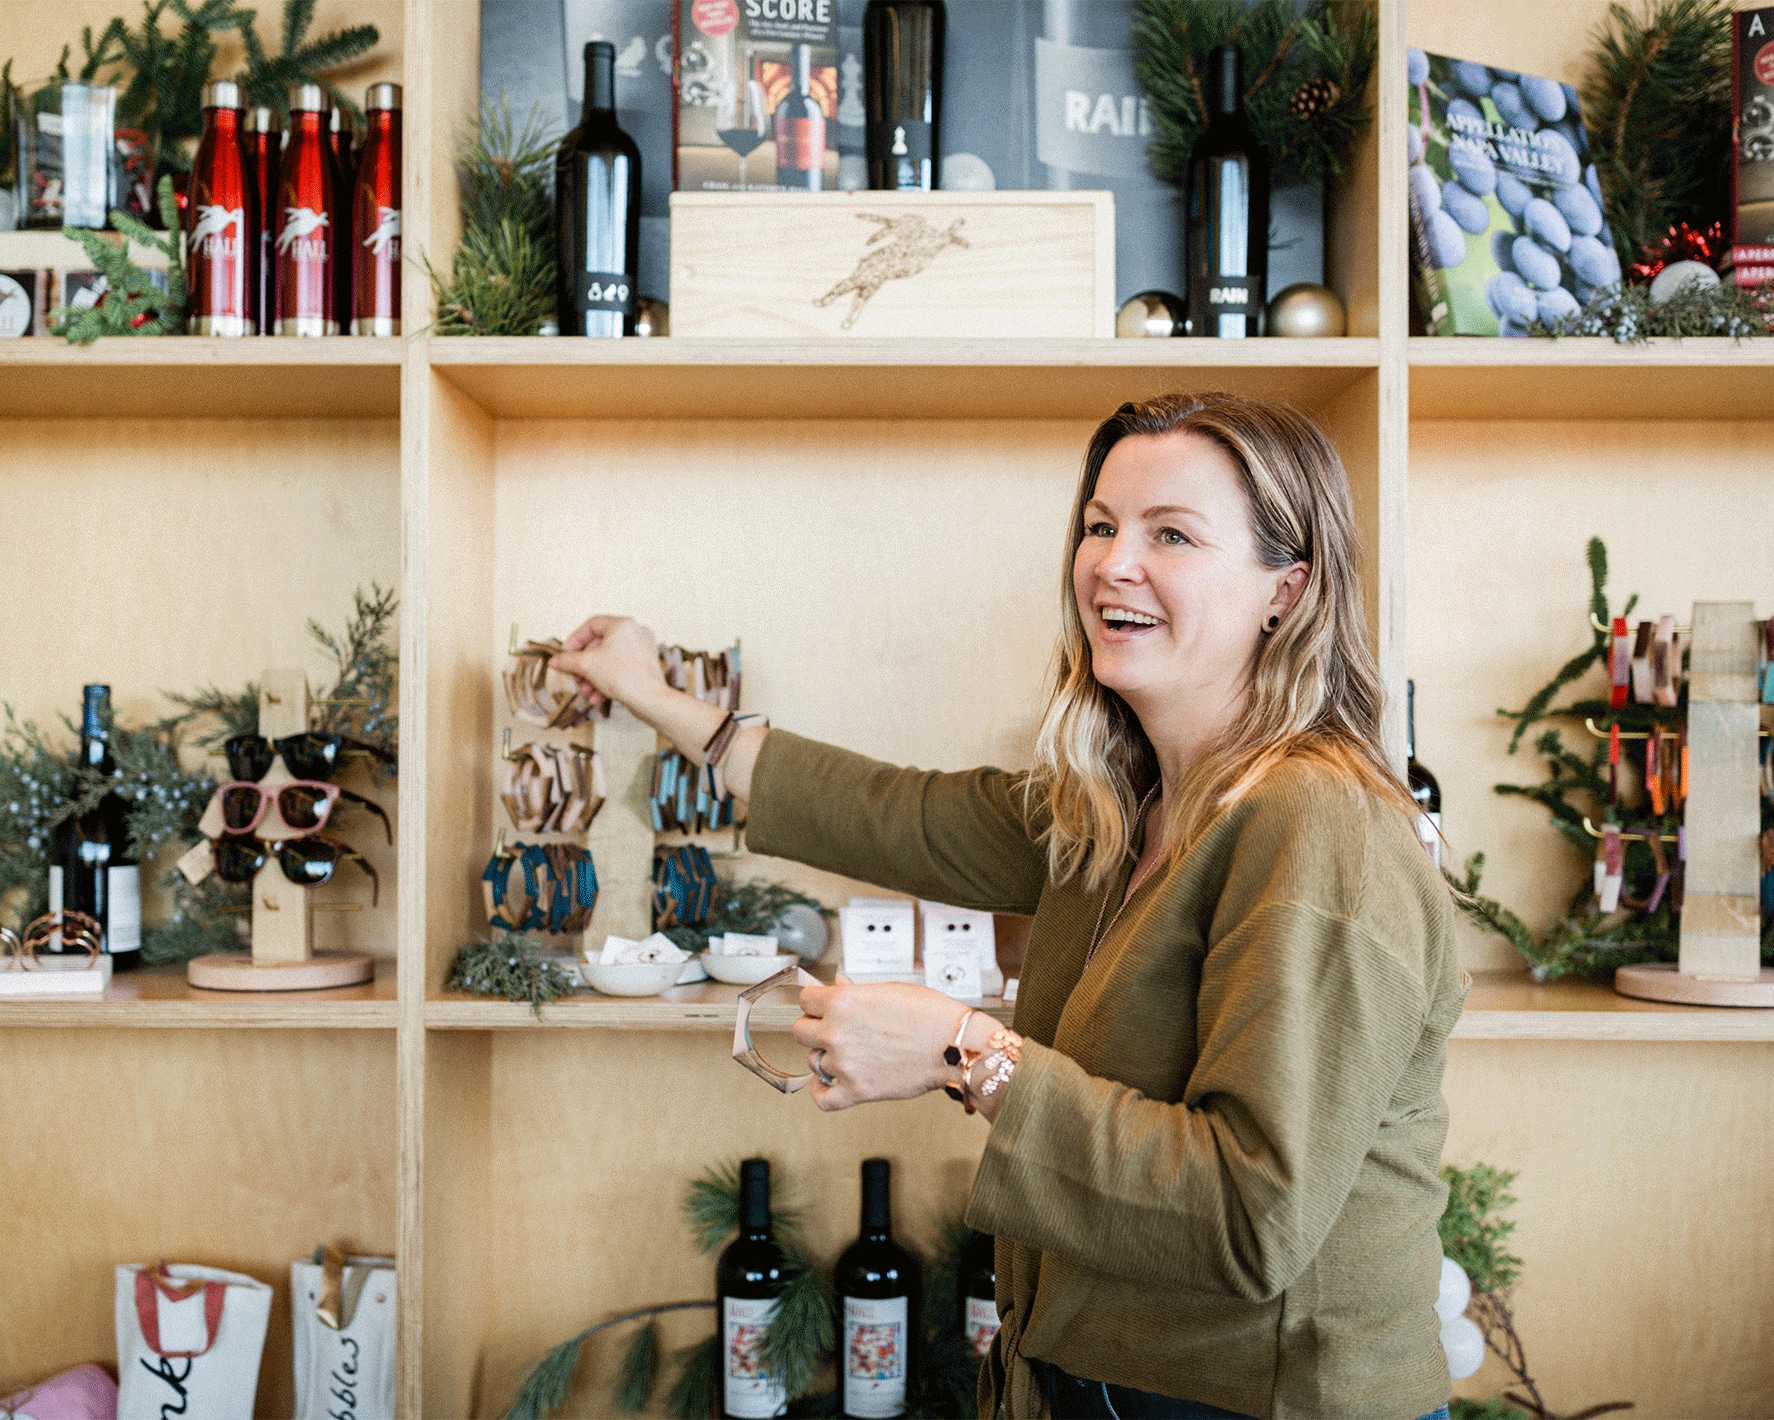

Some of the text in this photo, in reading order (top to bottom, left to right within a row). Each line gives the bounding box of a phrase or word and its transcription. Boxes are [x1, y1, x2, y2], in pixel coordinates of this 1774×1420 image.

[745, 0, 832, 23] SCORE
[1446, 113, 1563, 158] APPELLATION
[1451, 132, 1563, 174] NAPA VALLEY
[291, 239, 329, 261] HALL
[1210, 287, 1249, 304] RAIN
